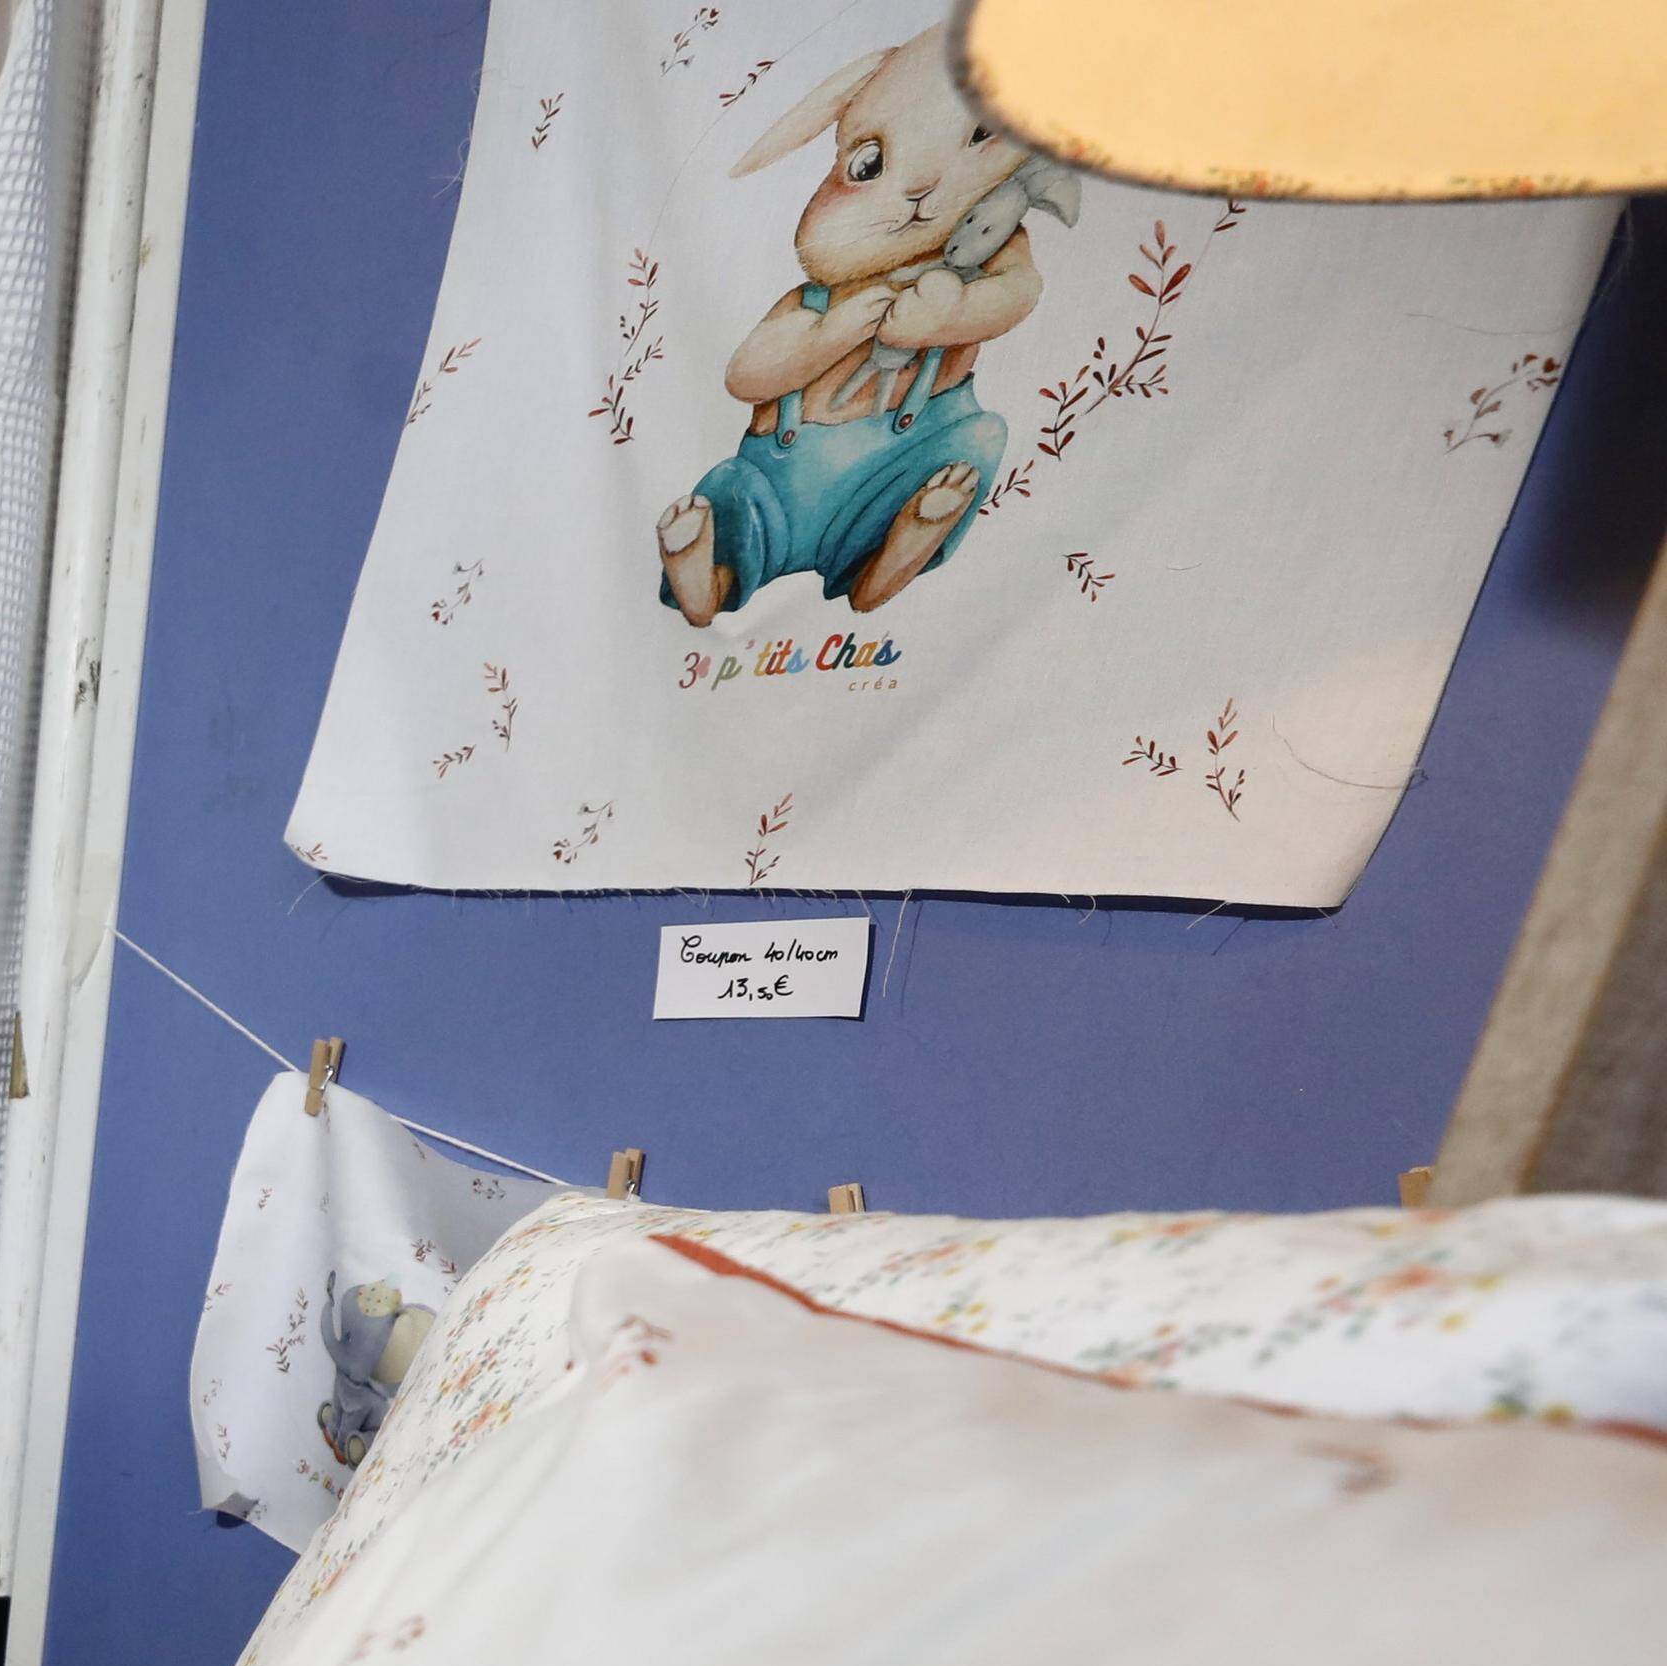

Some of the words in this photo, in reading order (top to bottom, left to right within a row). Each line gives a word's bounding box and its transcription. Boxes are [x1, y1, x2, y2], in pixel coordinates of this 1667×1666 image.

[848, 675, 898, 692] créa
[681, 935, 752, 967] Coupon
[717, 974, 794, 1001] 13,50€
